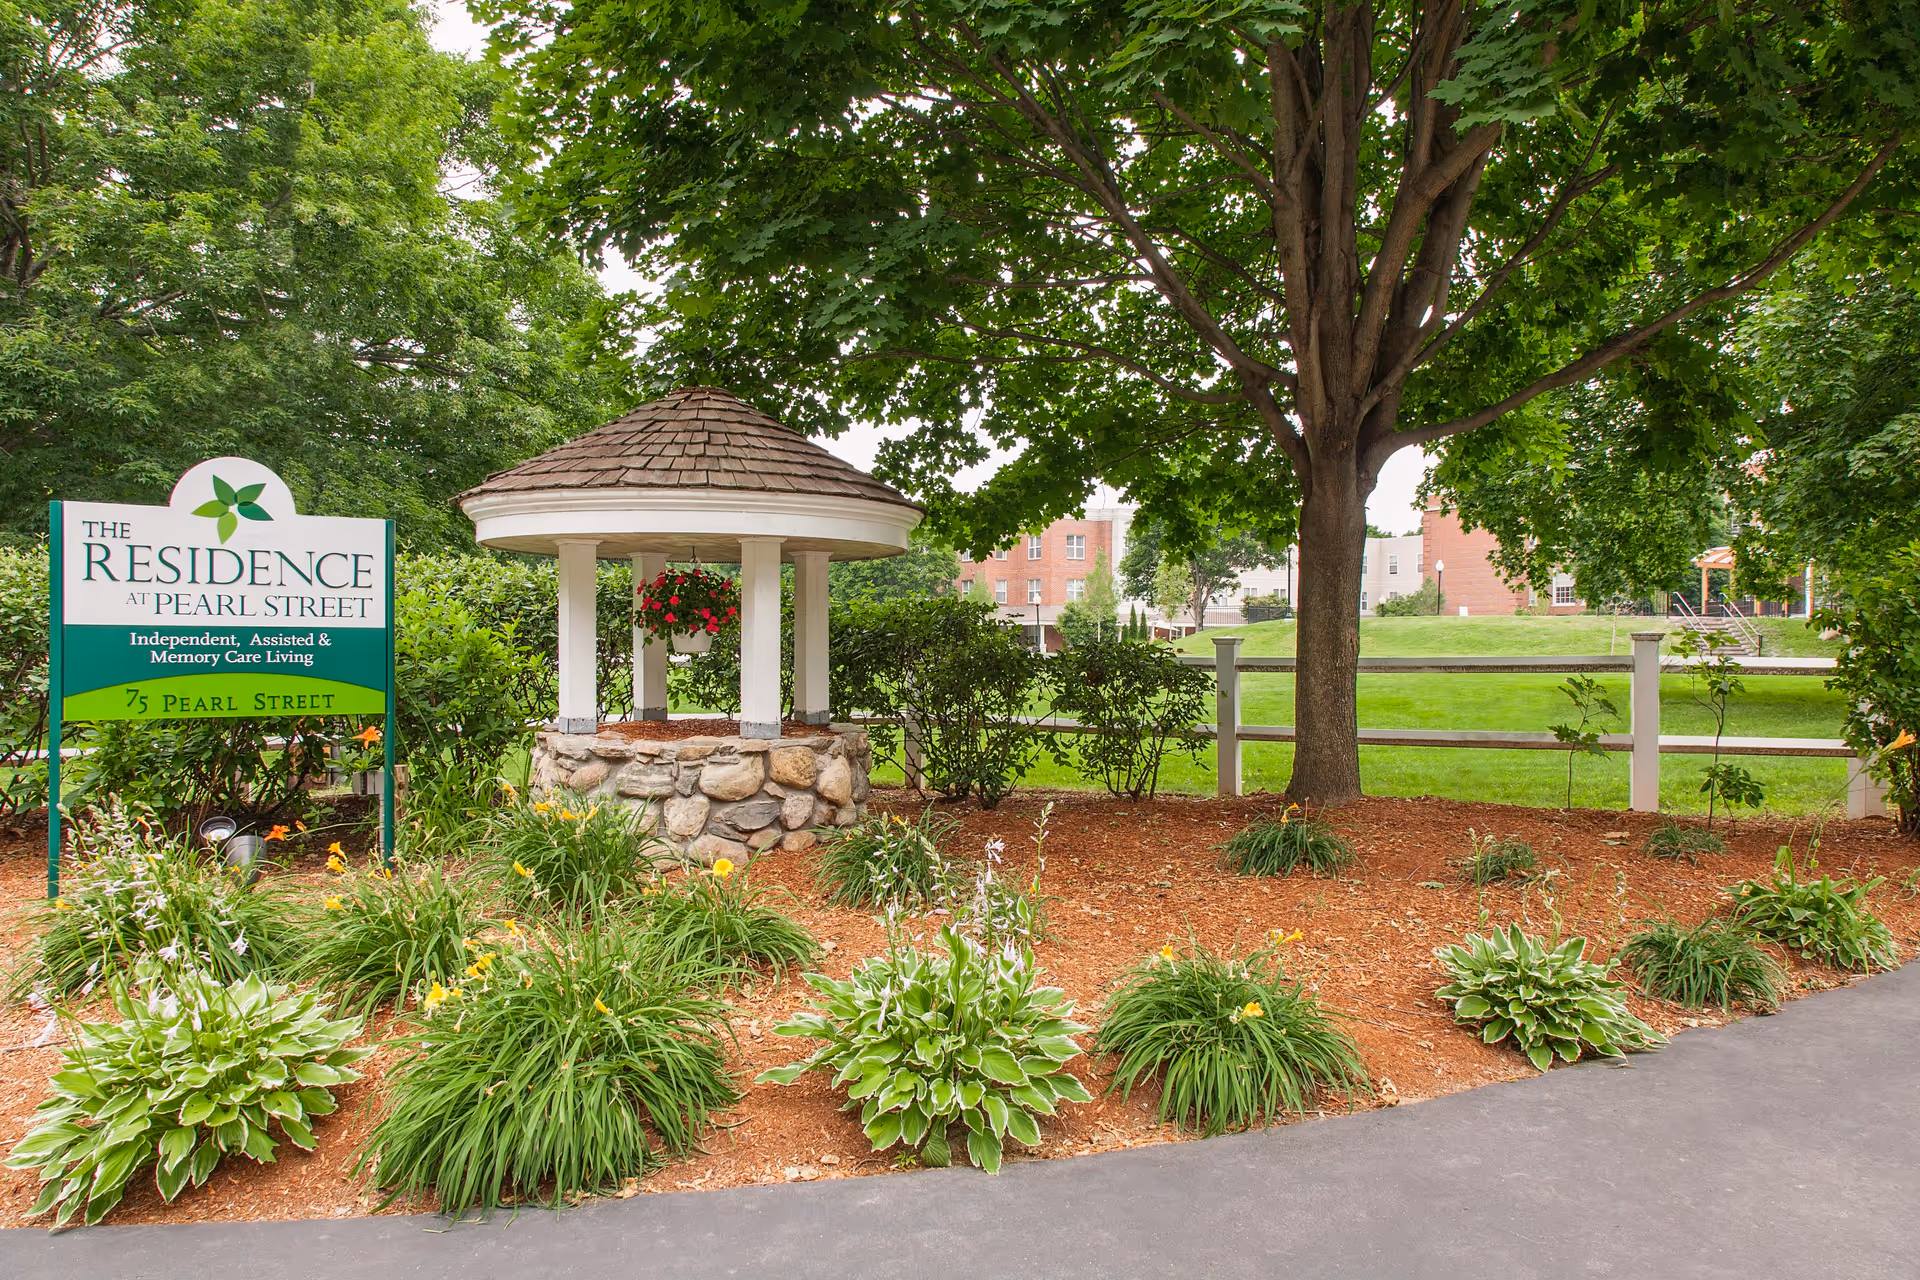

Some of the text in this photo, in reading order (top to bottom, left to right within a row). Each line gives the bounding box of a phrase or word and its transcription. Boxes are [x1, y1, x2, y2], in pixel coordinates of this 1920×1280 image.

[82, 520, 131, 539] THE
[82, 542, 375, 590] RESIDENCE
[126, 592, 373, 619] AT PEARL STREET
[130, 632, 332, 649] Independent, Assisted &
[150, 650, 314, 667] Memory Care Living
[126, 688, 335, 714] 75 PEARL STREET
